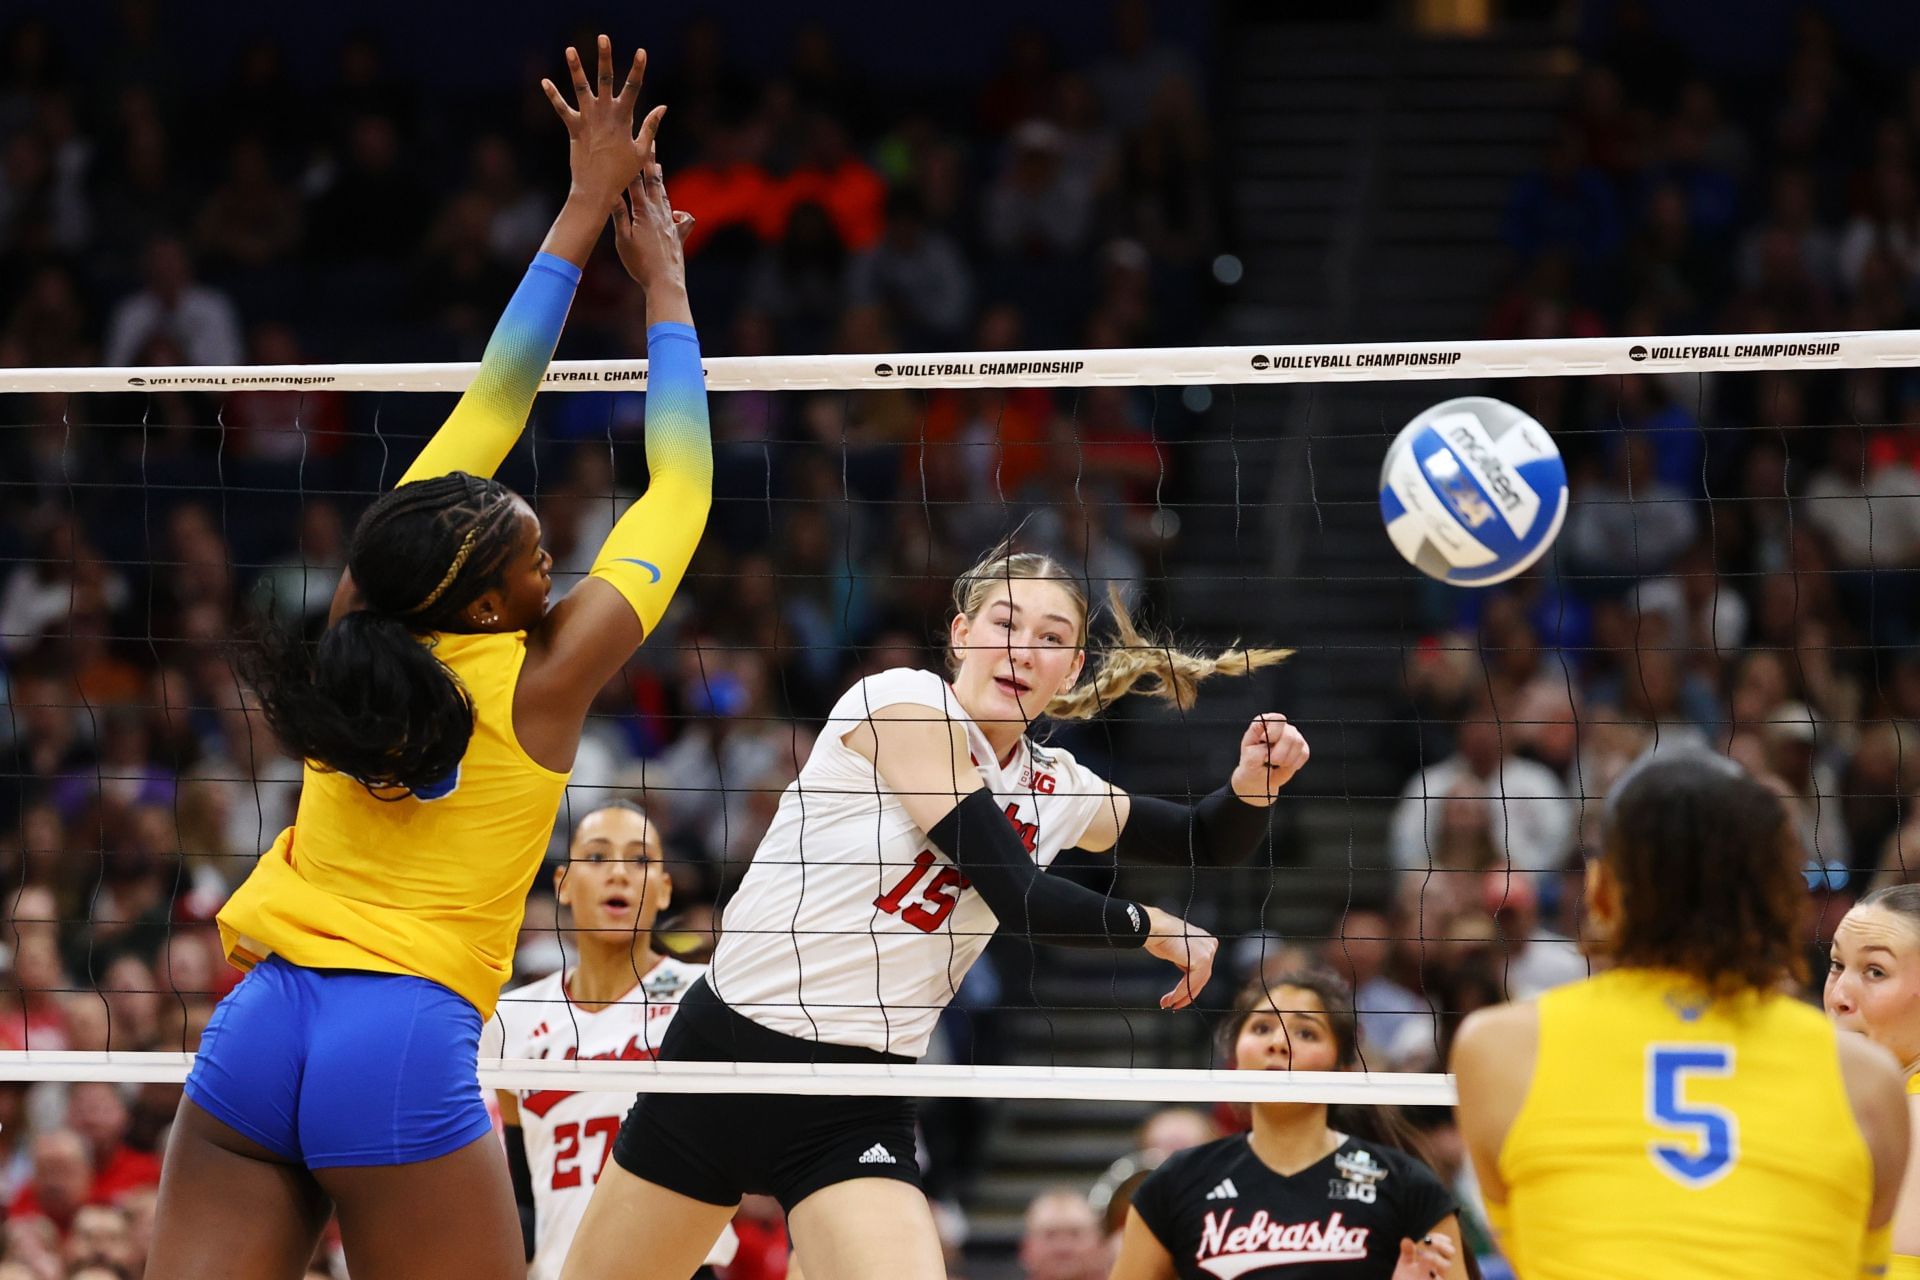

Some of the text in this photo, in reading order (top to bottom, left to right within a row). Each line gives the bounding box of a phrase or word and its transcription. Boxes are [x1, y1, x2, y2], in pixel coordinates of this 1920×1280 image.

[897, 364, 975, 377] VOLLEYBALL
[979, 361, 1084, 375] CHAMPIONSHIP
[1273, 355, 1352, 368] VOLLEYBALL
[1356, 353, 1461, 366] CHAMPIONSHIP
[1651, 346, 1730, 359] VOLLEYBALL
[1734, 343, 1840, 357] CHAMPIONSHIP
[231, 376, 336, 385] CHAMPIONSHIP
[1450, 427, 1523, 512] molten
[873, 849, 970, 933] 15
[1644, 1040, 1740, 1190] 5
[551, 1115, 620, 1191] 27
[1196, 1207, 1369, 1260] Nebraska
